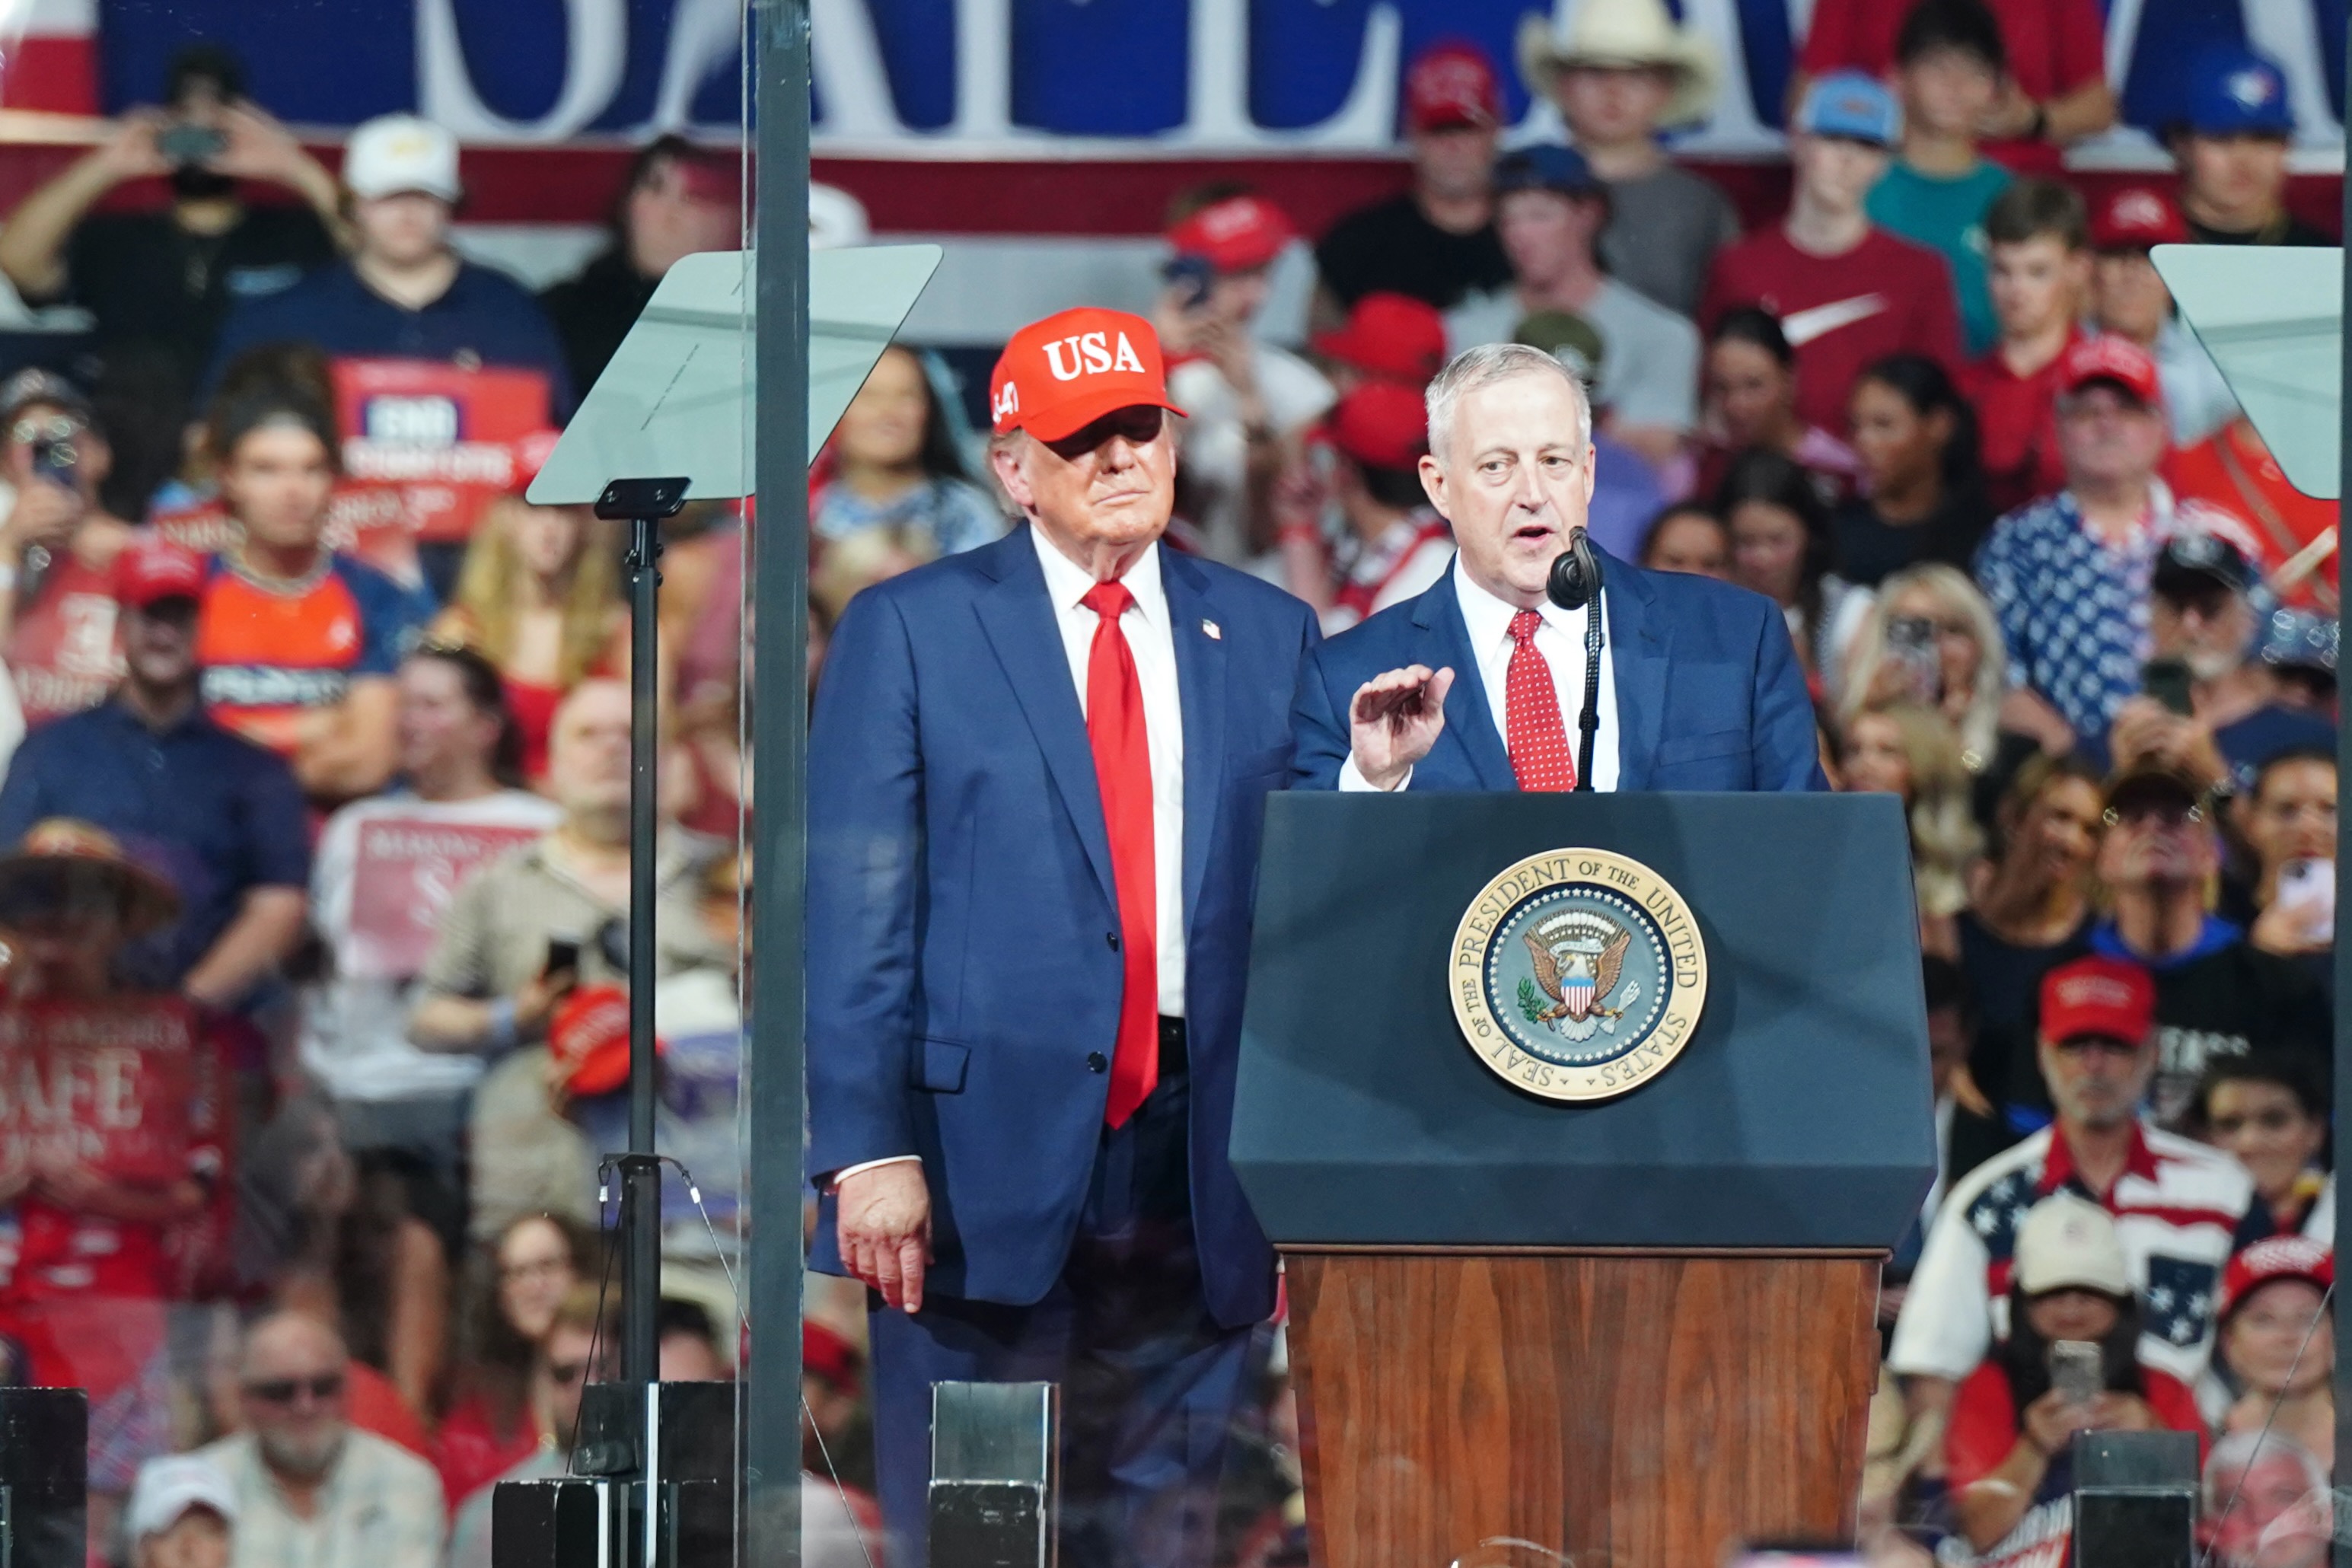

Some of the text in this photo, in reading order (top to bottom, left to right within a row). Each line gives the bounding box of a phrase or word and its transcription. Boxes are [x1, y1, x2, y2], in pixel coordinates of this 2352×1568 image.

[1042, 331, 1146, 381] USA
[1459, 859, 1698, 1088] SEAL OF THE PRESIDENT OF THE UNITED STATES
